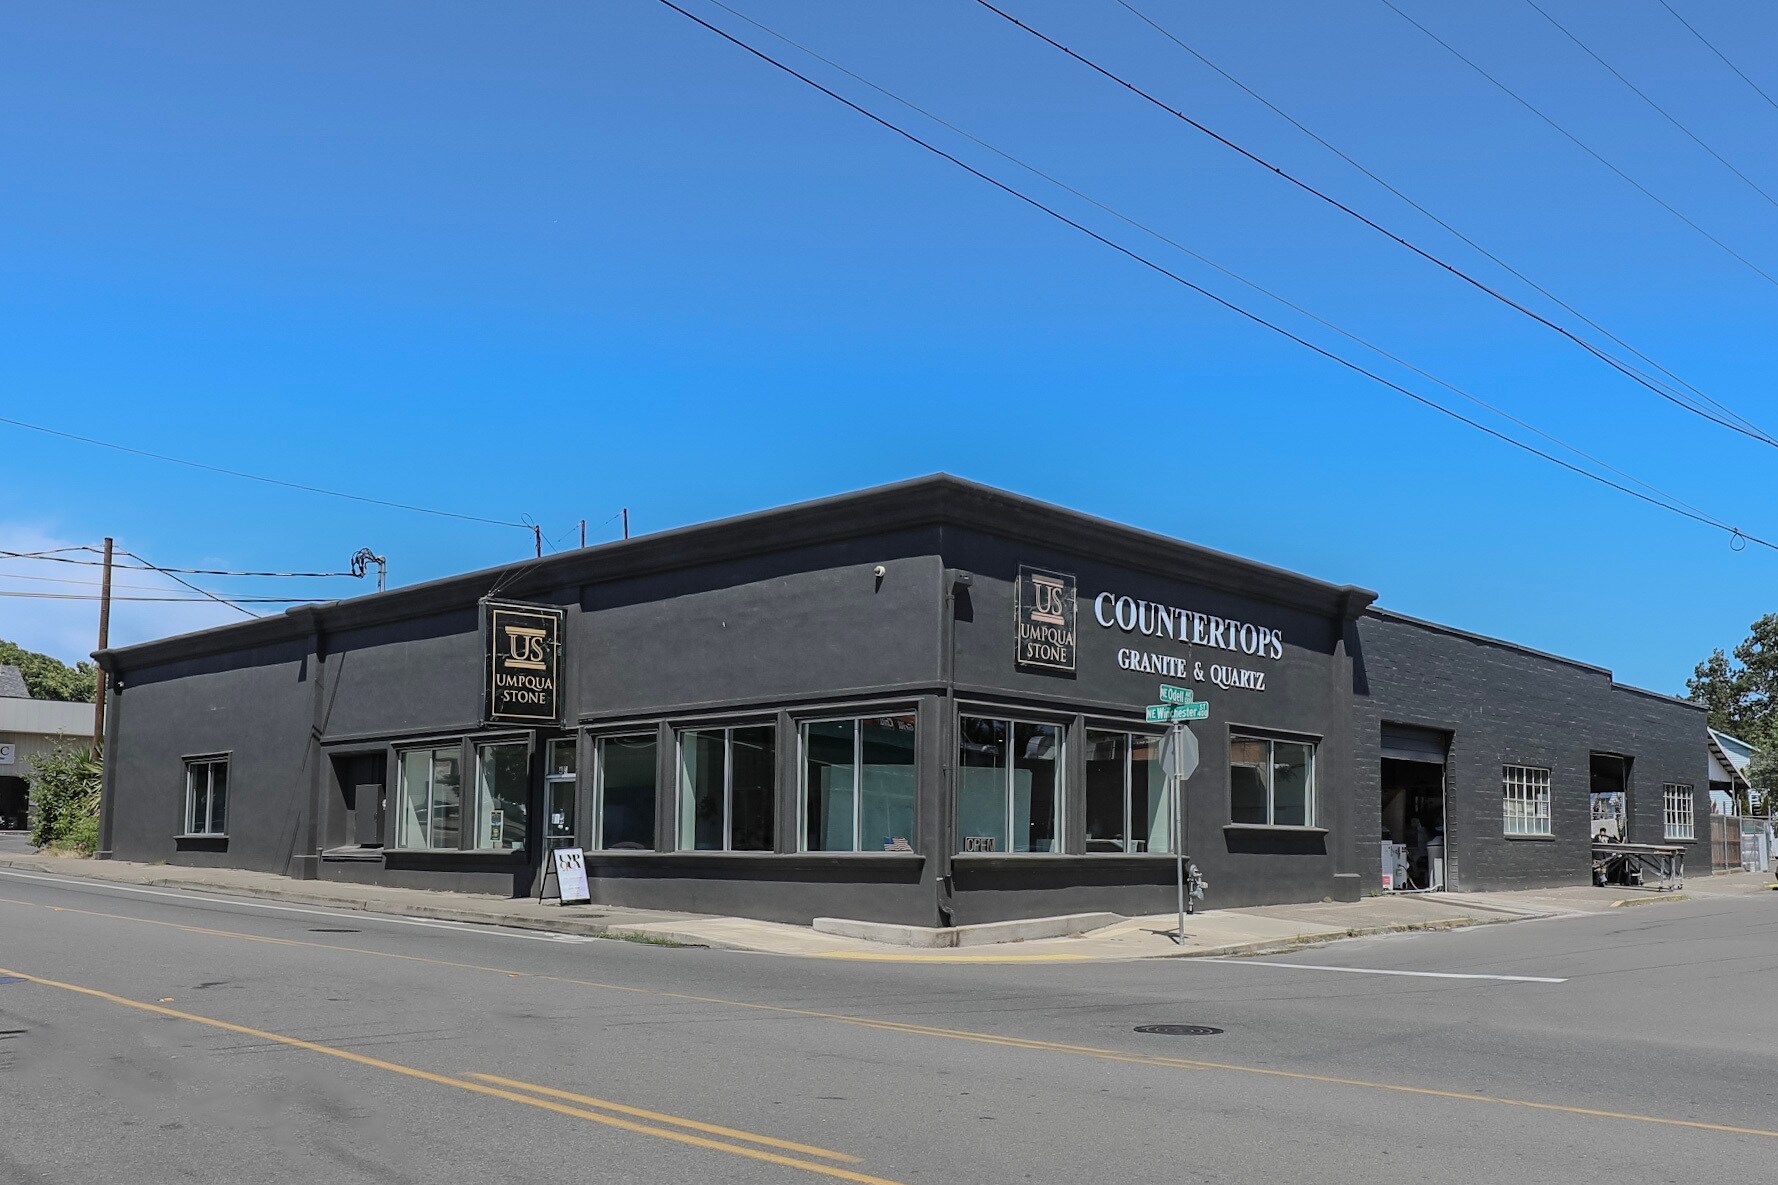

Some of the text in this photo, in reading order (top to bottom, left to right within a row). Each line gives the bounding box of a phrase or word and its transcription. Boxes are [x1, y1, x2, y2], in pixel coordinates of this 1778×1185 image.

[1034, 583, 1063, 615] US
[1021, 623, 1073, 648] UMPQUA
[1094, 592, 1283, 660] COUNTERTOPS
[508, 634, 544, 661] US
[1027, 642, 1067, 662] STONE
[1117, 648, 1266, 691] GRANITE & QUARTZ
[496, 674, 553, 691] UMPQUA
[503, 690, 546, 704] STONE
[1161, 687, 1168, 698] NE
[1168, 689, 1184, 703] Odell
[1147, 709, 1156, 719] NE
[966, 838, 994, 852] OPEN
